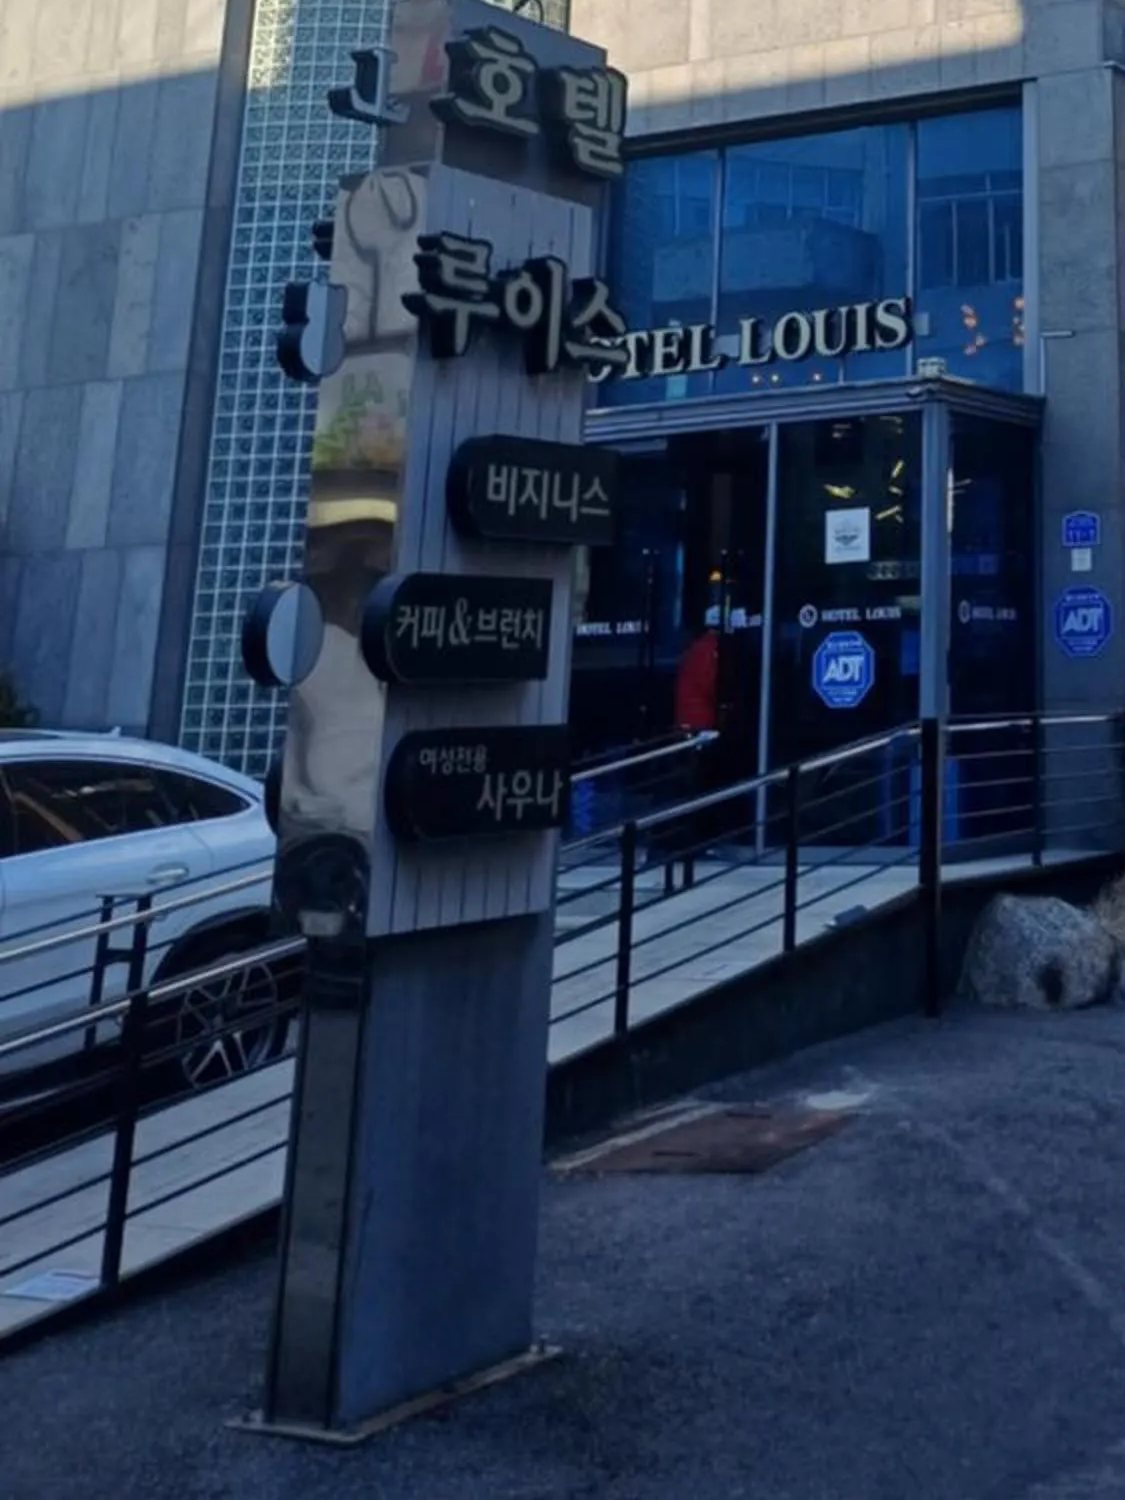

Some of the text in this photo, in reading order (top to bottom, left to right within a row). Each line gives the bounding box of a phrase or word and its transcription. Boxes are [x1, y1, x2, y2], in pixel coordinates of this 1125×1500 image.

[440, 26, 629, 178] 호텔
[416, 232, 629, 373] 루이스
[738, 296, 909, 366] LOUIS
[486, 463, 611, 522] 비지니스
[396, 597, 545, 650] 커피&브런치
[1062, 607, 1103, 634] ADT
[822, 655, 864, 683] ADT
[476, 769, 563, 822] 사우나
